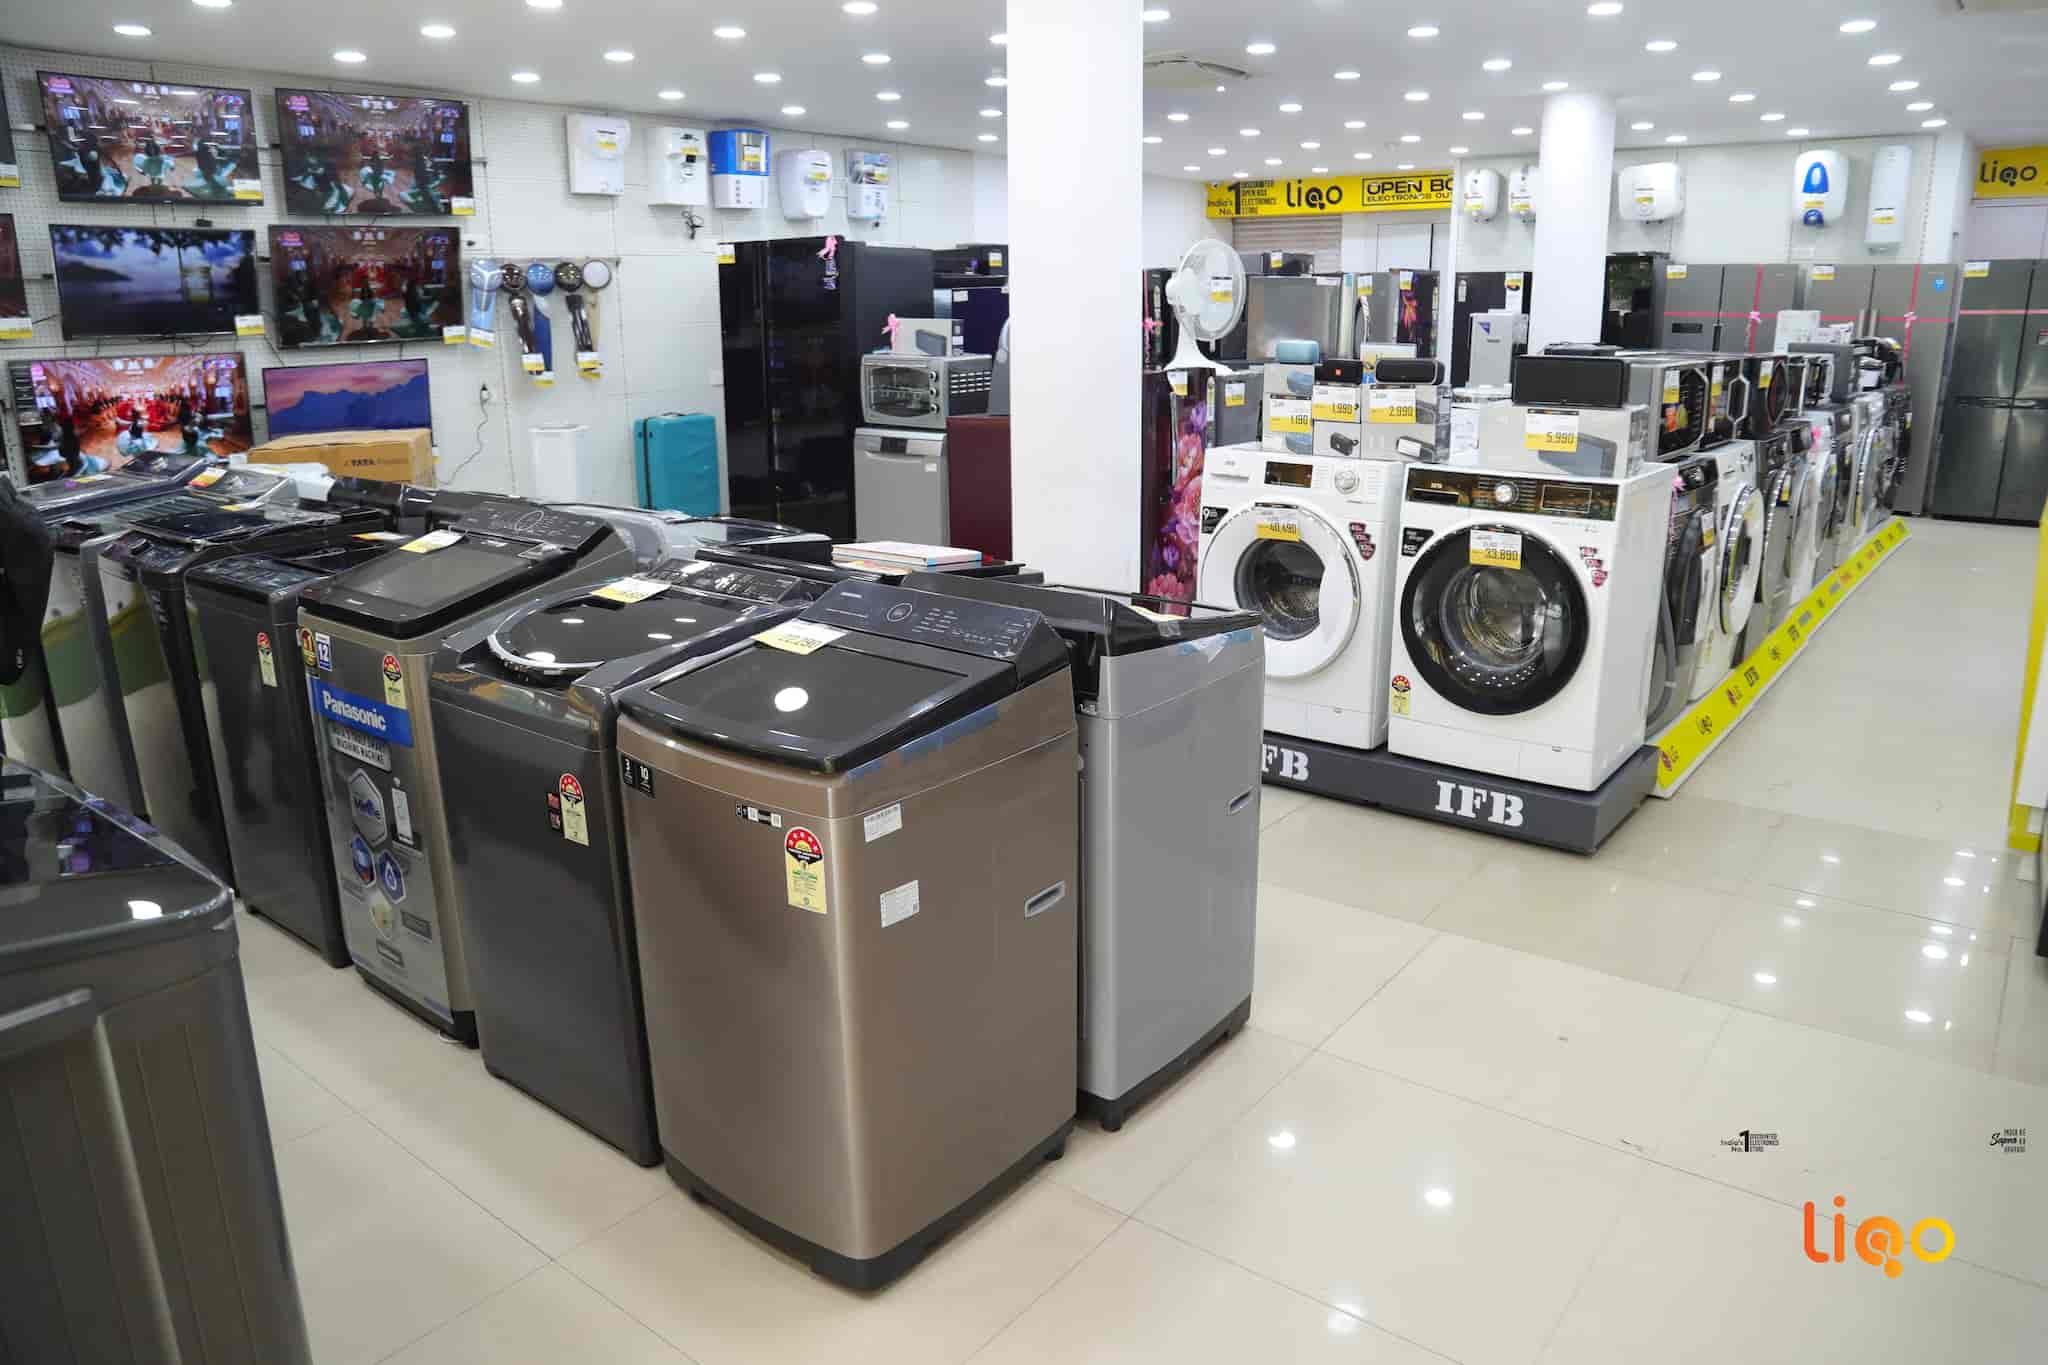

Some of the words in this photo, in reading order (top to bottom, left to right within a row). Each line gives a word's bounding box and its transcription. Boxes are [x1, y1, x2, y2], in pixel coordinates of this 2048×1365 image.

[1367, 179, 1422, 195] OPEN
[322, 690, 387, 732] Panasonic
[1262, 743, 1309, 781] FB
[1435, 779, 1524, 827] IFB
